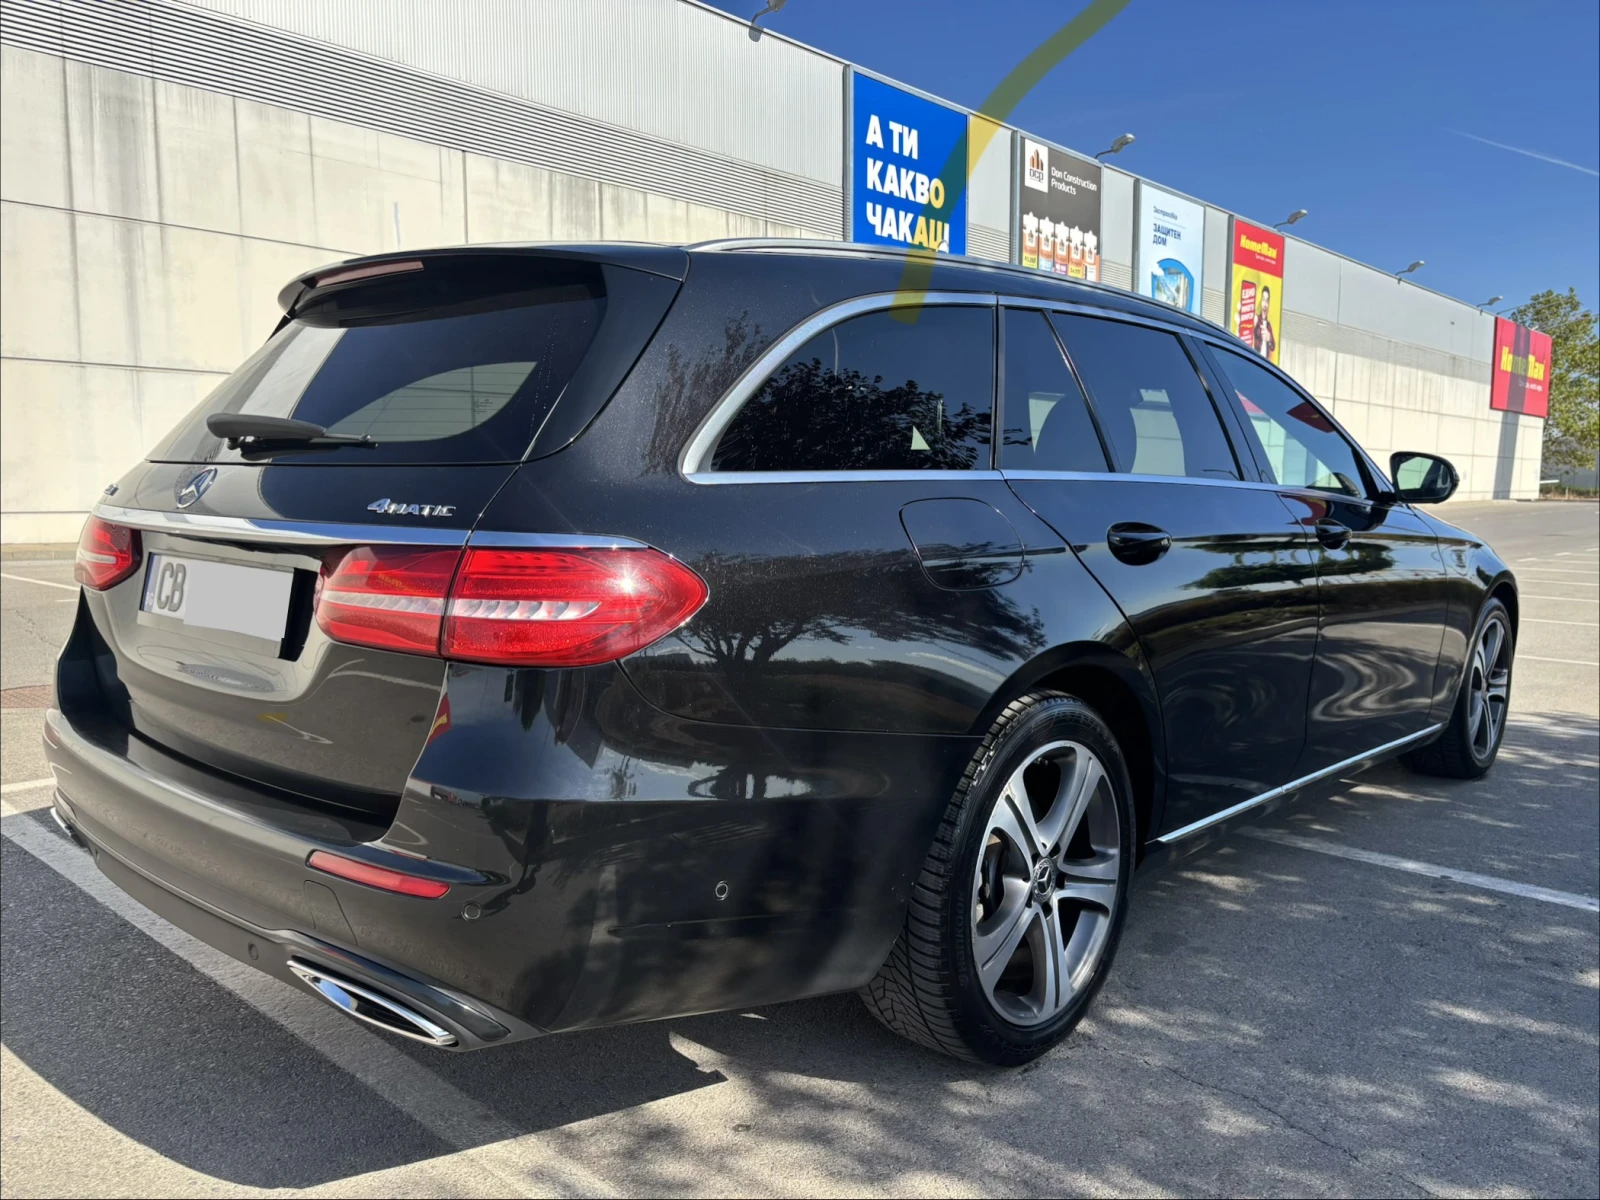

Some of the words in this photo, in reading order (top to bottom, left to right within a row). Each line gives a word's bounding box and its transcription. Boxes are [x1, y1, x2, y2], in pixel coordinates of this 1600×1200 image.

[866, 114, 884, 149] А
[889, 120, 918, 160] ТИ
[866, 157, 945, 209] КАКВО
[1051, 166, 1063, 179] Don
[1063, 171, 1098, 192] Construction
[1051, 178, 1077, 195] Products
[1152, 234, 1167, 247] ДОМ
[1153, 223, 1182, 241] ЗАЩИТЕН
[1240, 234, 1278, 259] HomeMax
[1501, 346, 1545, 381] HomeMax
[367, 498, 456, 517] 4MATIC
